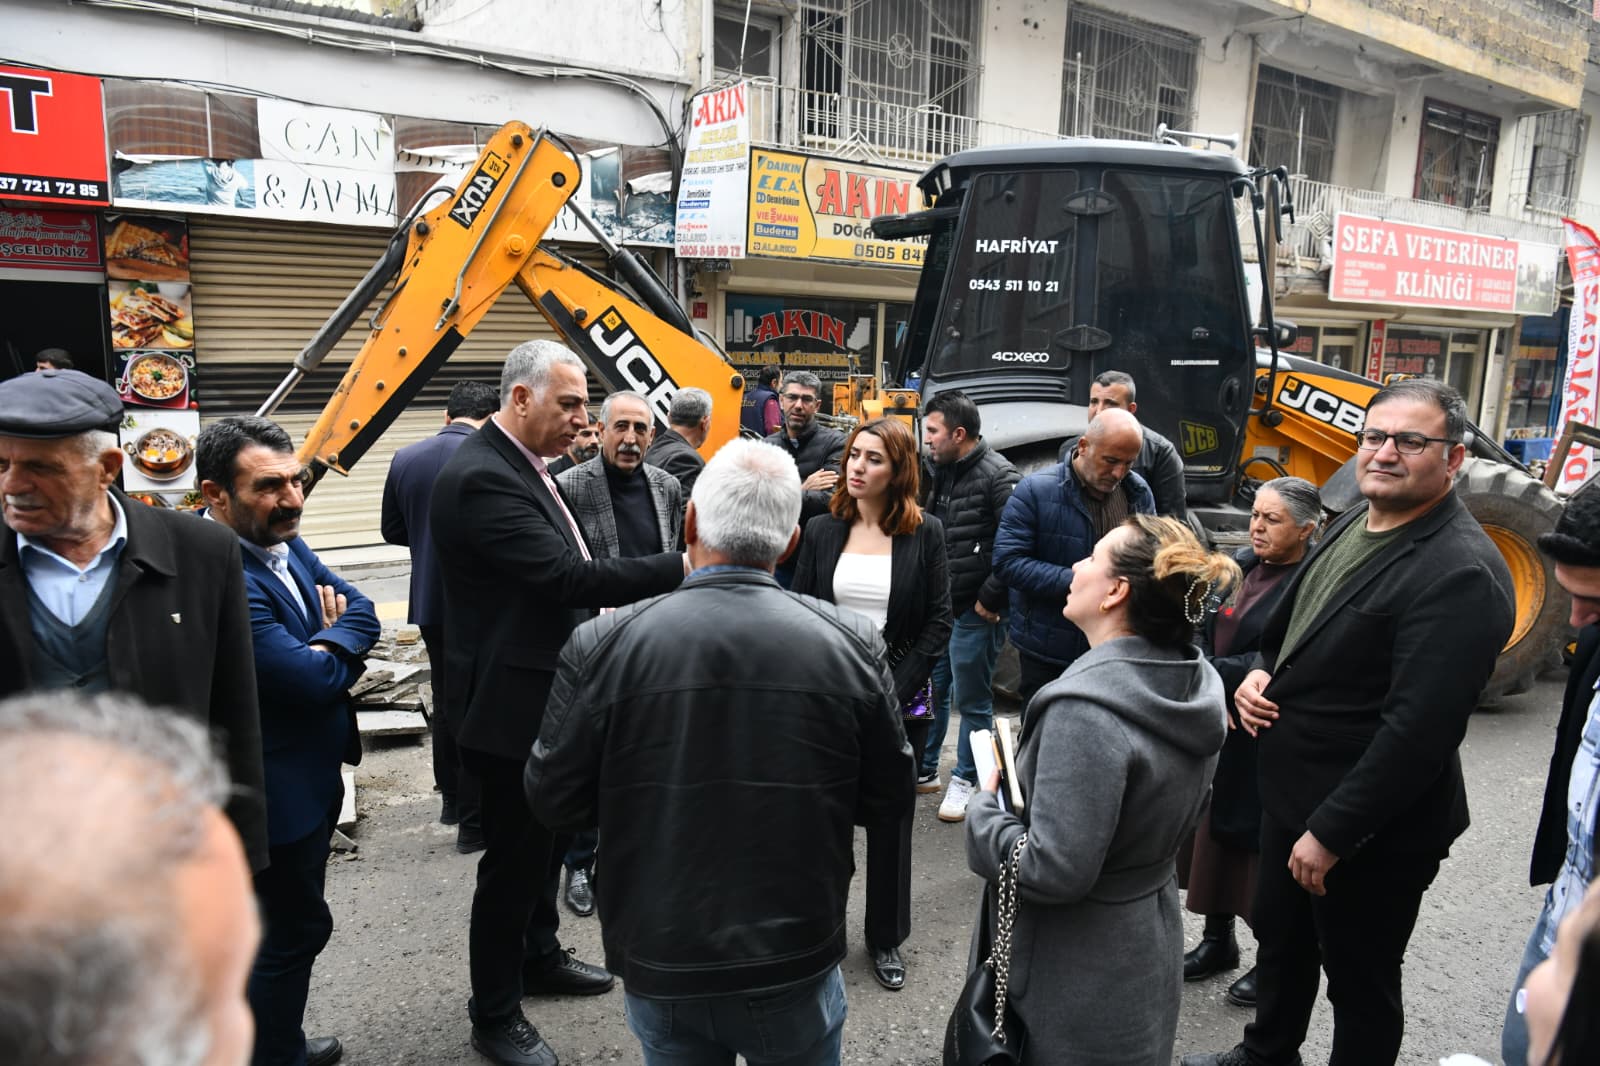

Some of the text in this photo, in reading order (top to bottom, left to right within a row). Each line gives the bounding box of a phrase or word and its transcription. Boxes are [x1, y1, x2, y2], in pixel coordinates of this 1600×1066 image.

[694, 84, 745, 127] AKIN
[284, 118, 380, 161] CAN
[767, 160, 801, 173] DAIKIN
[21, 178, 51, 193] 721
[55, 181, 76, 195] 72
[79, 183, 99, 197] 85
[816, 168, 912, 219] AKIN
[755, 223, 797, 237] Buderus
[975, 236, 1060, 255] HAFRİYAT
[0, 243, 88, 258] ŞGELDİNİZ
[854, 243, 896, 260] 0505
[1342, 225, 1516, 271] SEFA VETERİNER
[969, 279, 1060, 292] 0543 511 10 21
[1395, 268, 1473, 301] KLİNİĞİ
[752, 309, 847, 350] AKIN
[1279, 384, 1367, 434] JCB
[1184, 423, 1217, 454] JCB
